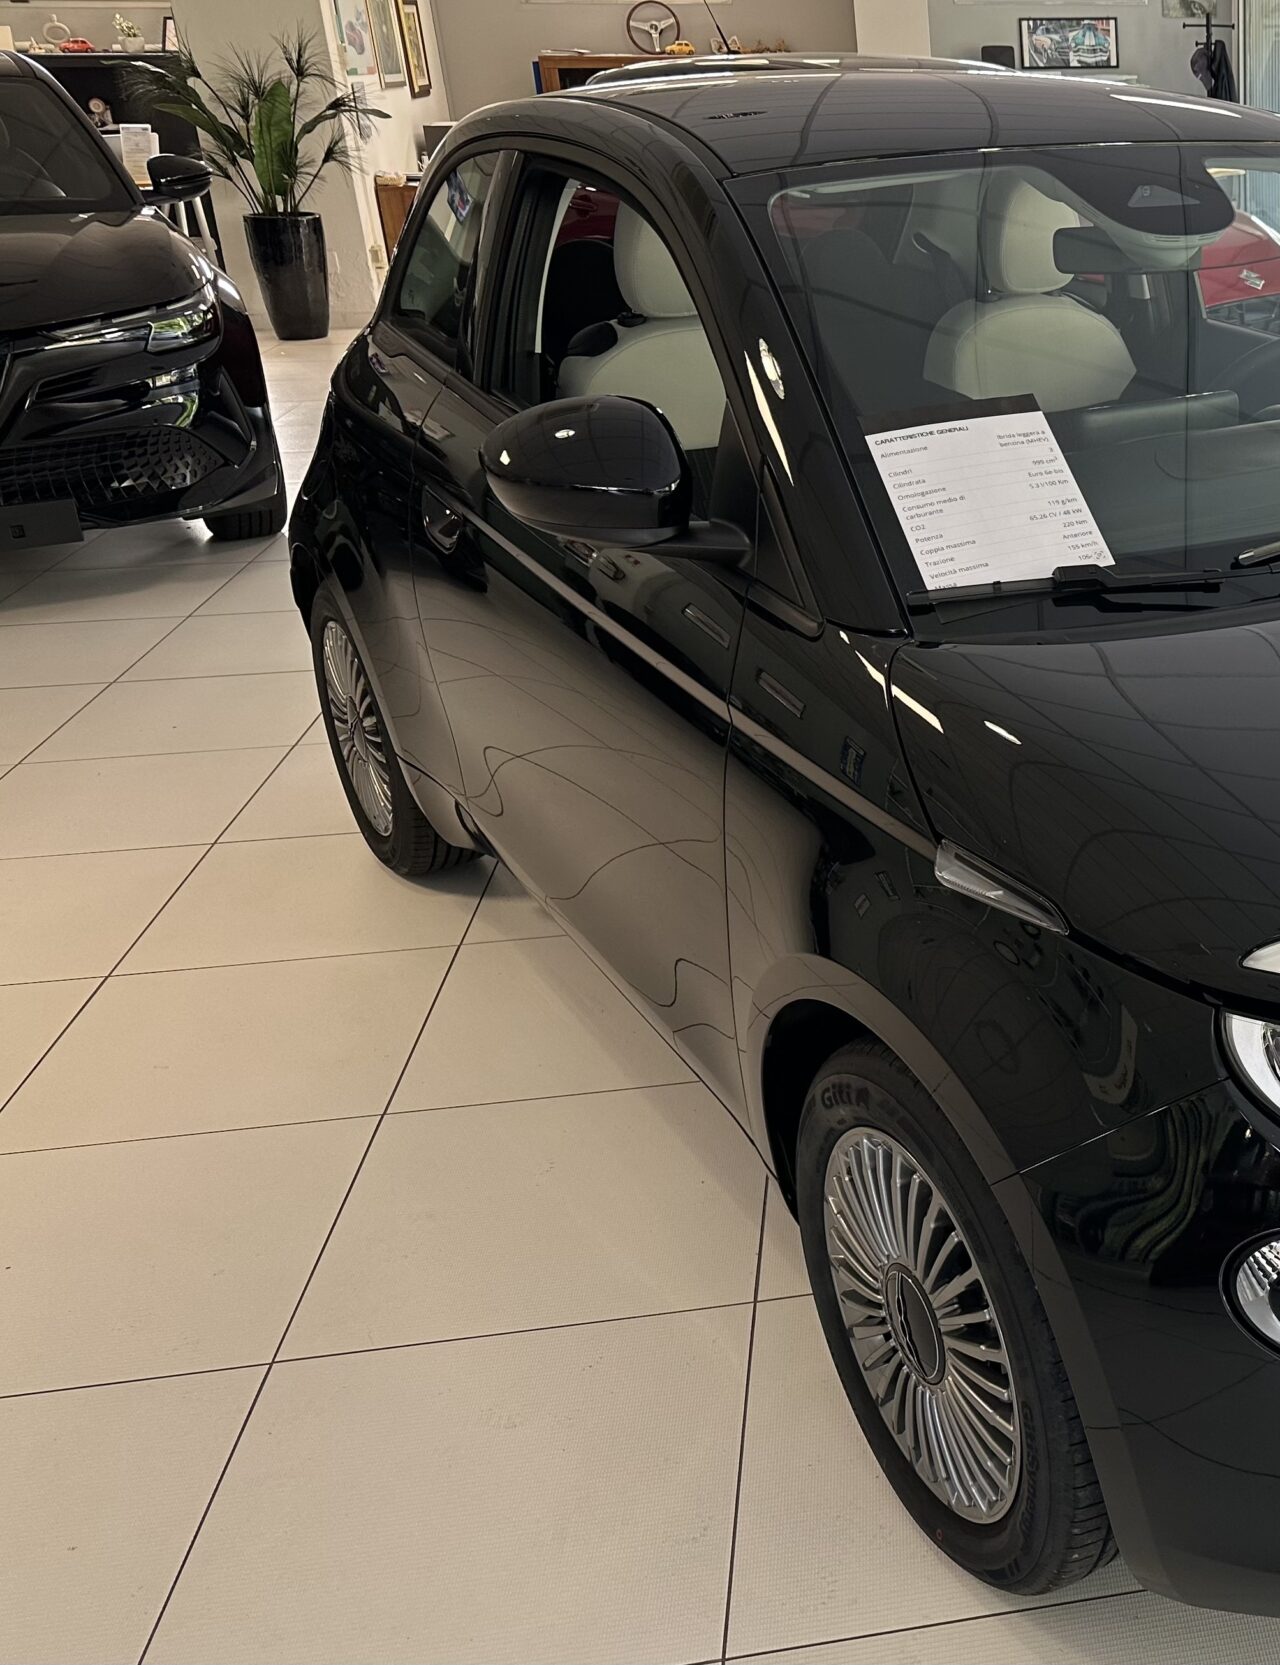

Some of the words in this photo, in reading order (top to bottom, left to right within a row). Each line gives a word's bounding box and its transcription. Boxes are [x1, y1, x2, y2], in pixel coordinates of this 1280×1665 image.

[874, 430, 936, 446] CARATTERISTICHE
[936, 426, 969, 435] GENERALI
[1025, 437, 1049, 446] (MHEV)
[880, 445, 928, 459] Alimentazione
[888, 468, 912, 478] Cilindri
[893, 479, 926, 489] Cilindrata
[897, 486, 947, 501] Omologazione
[902, 502, 935, 513] Consumo
[936, 497, 958, 505] medio
[1061, 497, 1078, 505] g/km
[906, 508, 944, 521] carburante
[910, 524, 926, 532] CO2
[914, 533, 944, 544] Potenza
[1062, 530, 1093, 540] Anteriore
[920, 546, 945, 557] Coppia
[946, 539, 977, 550] massima
[1081, 540, 1099, 549] km/h
[924, 557, 955, 568] Trazione
[929, 567, 957, 580] Velocità
[958, 561, 990, 573] massima
[821, 1082, 854, 1109] Giti
